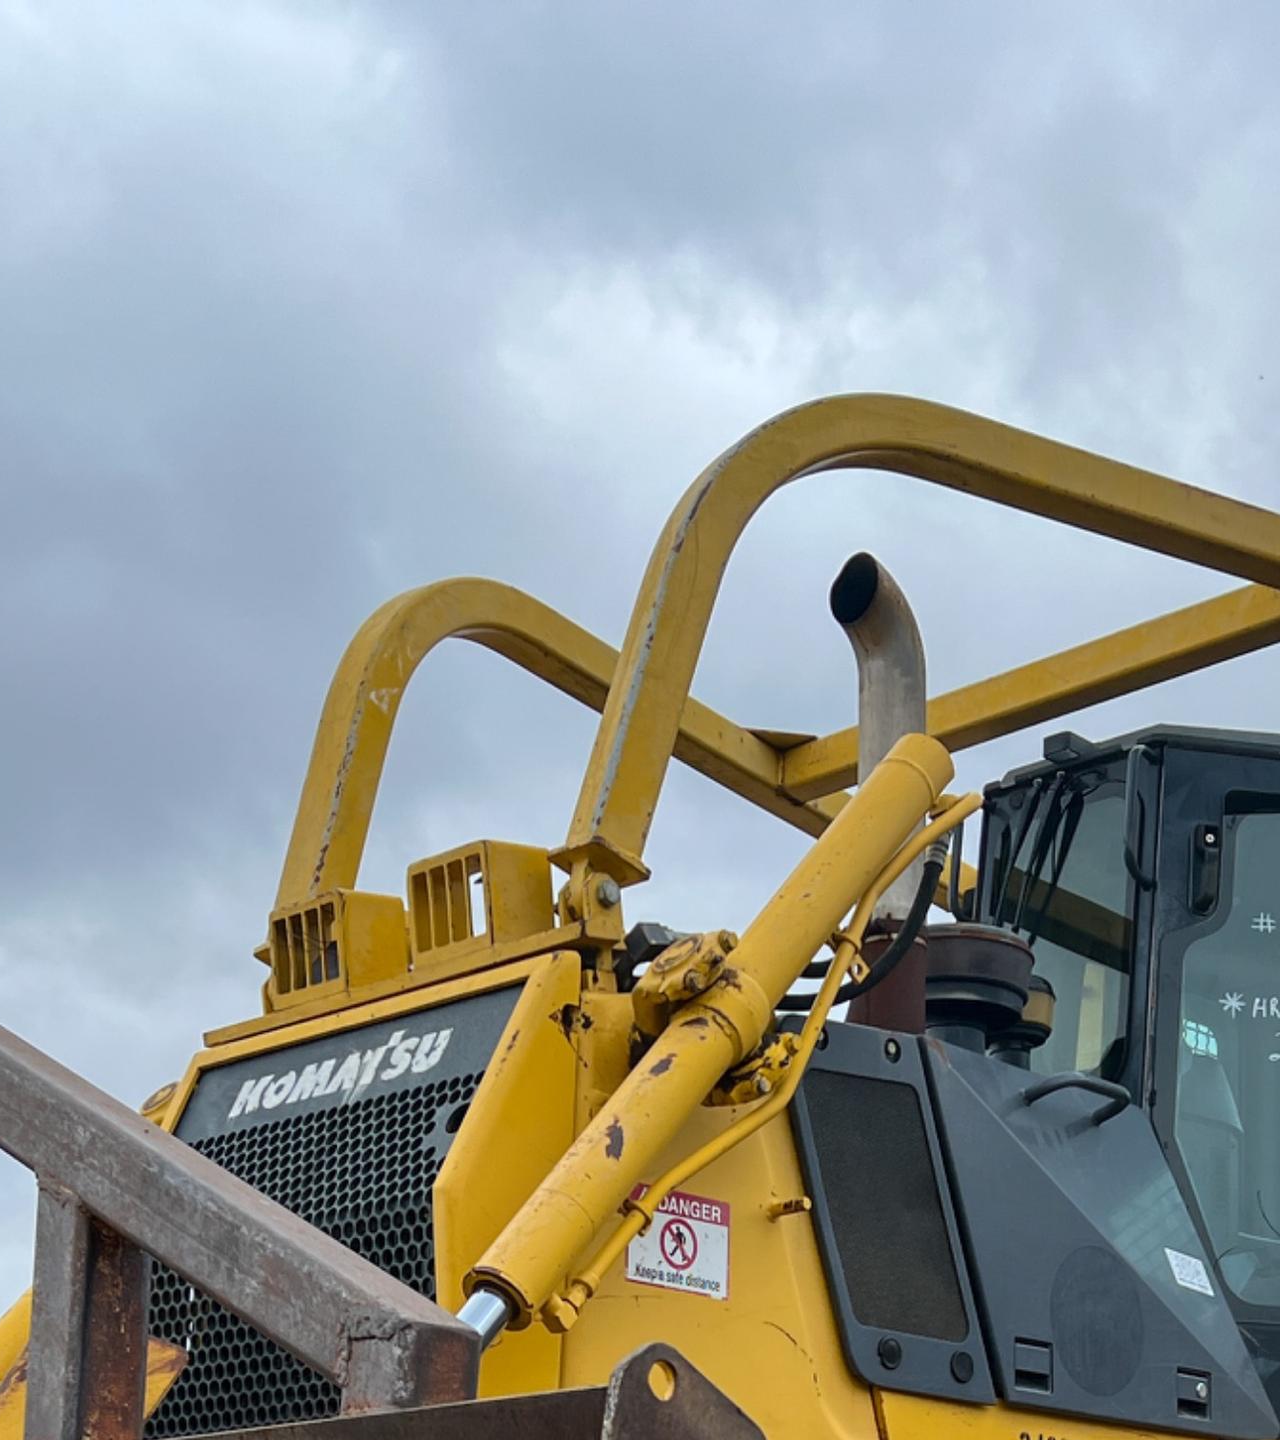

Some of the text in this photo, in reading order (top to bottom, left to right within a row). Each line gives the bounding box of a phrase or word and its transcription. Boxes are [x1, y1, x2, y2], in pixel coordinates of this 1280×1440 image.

[228, 1027, 454, 1119] KOMATSU
[658, 1196, 722, 1223] DANGER
[634, 1263, 658, 1282] Keep
[666, 1271, 684, 1286] safe
[686, 1274, 721, 1292] distance
